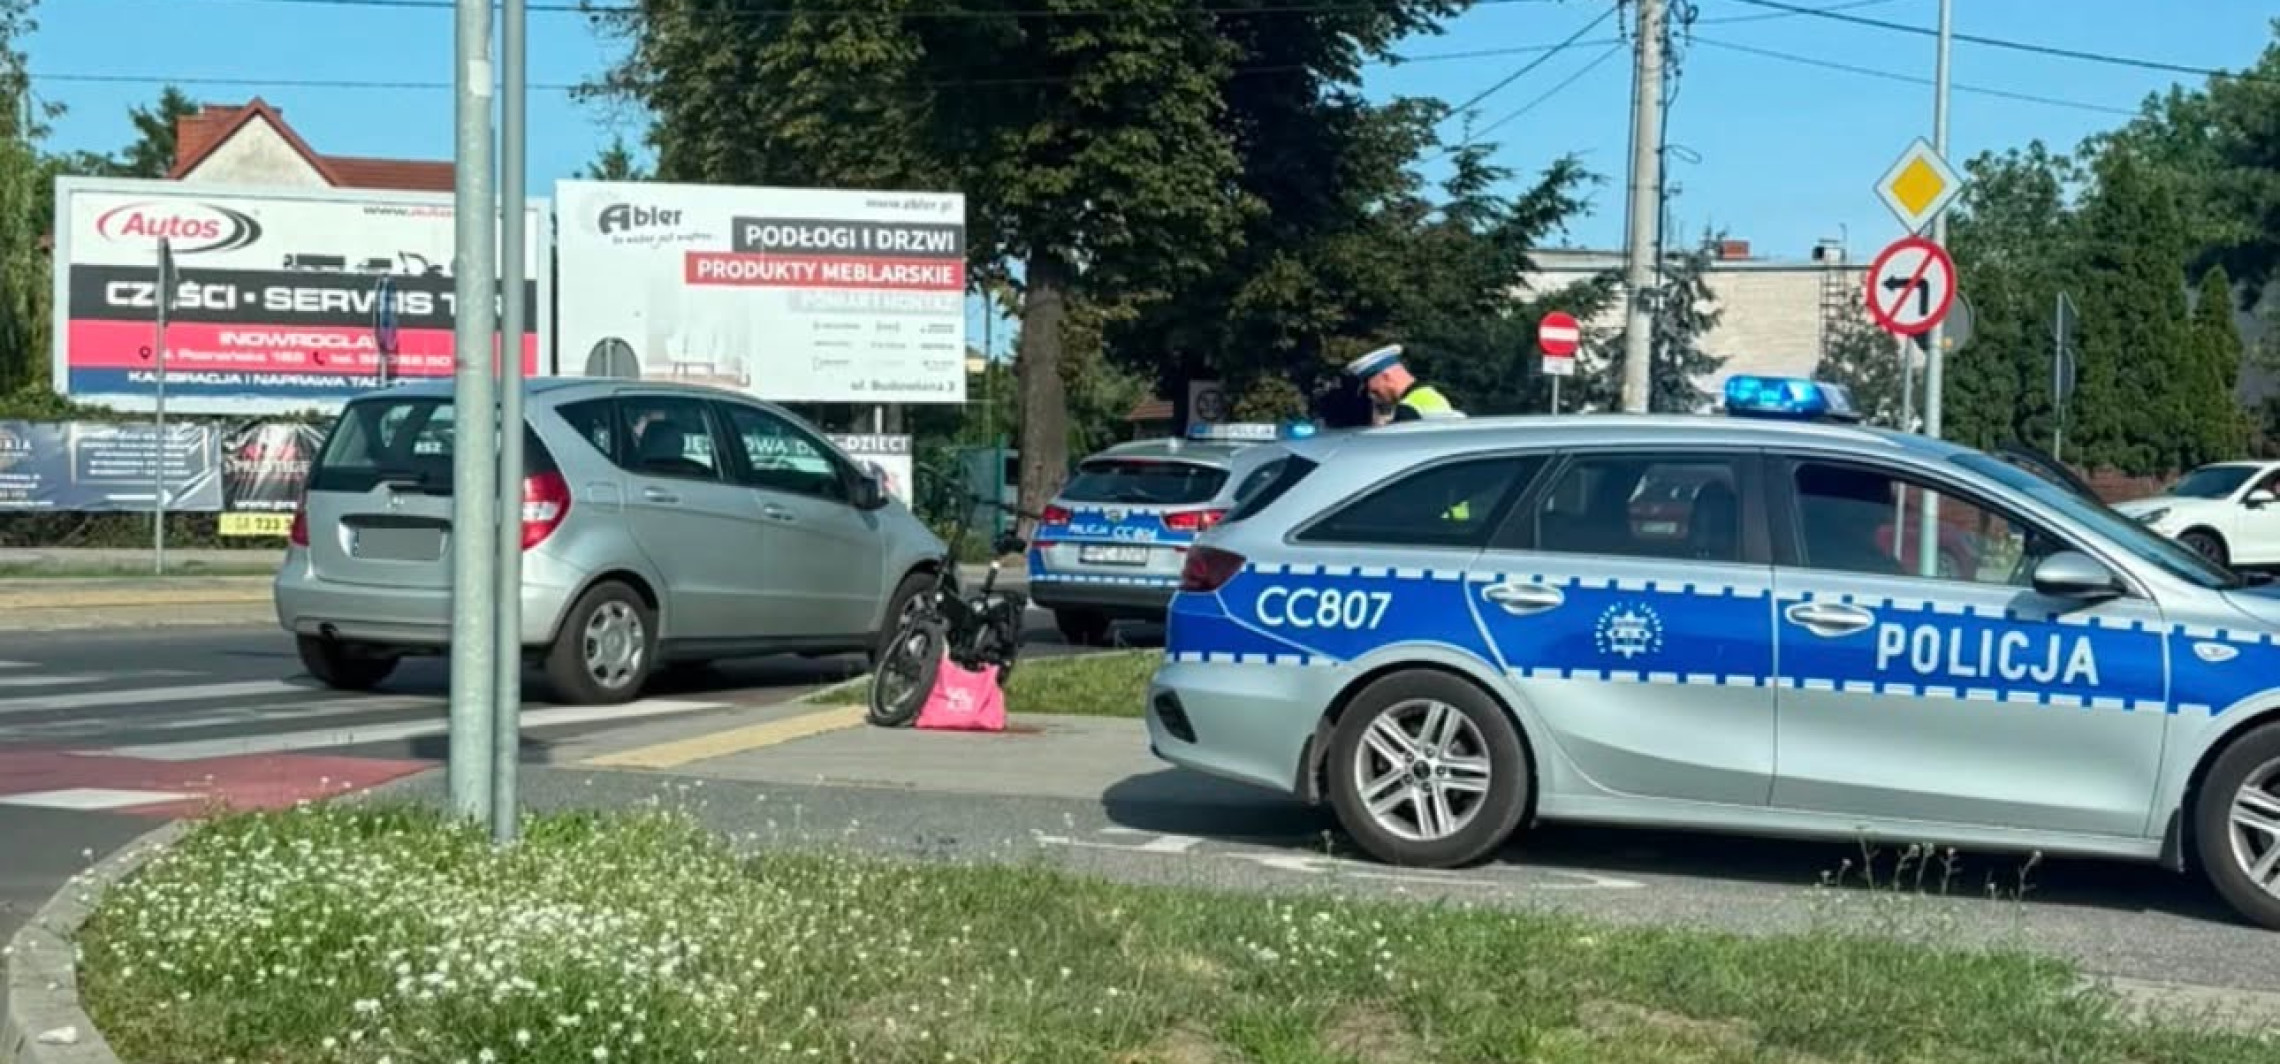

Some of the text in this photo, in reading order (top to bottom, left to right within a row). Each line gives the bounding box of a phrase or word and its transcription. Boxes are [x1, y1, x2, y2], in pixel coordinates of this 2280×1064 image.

[121, 212, 220, 239] Autos
[598, 204, 682, 235] Abler
[745, 224, 955, 252] PODŁOGI I DRZWI
[697, 257, 955, 285] PRODUKTY MEBLARSKIE
[105, 280, 236, 311] CZŚCI
[1255, 586, 1392, 630] CC807
[1876, 622, 2098, 686] POLICJA
